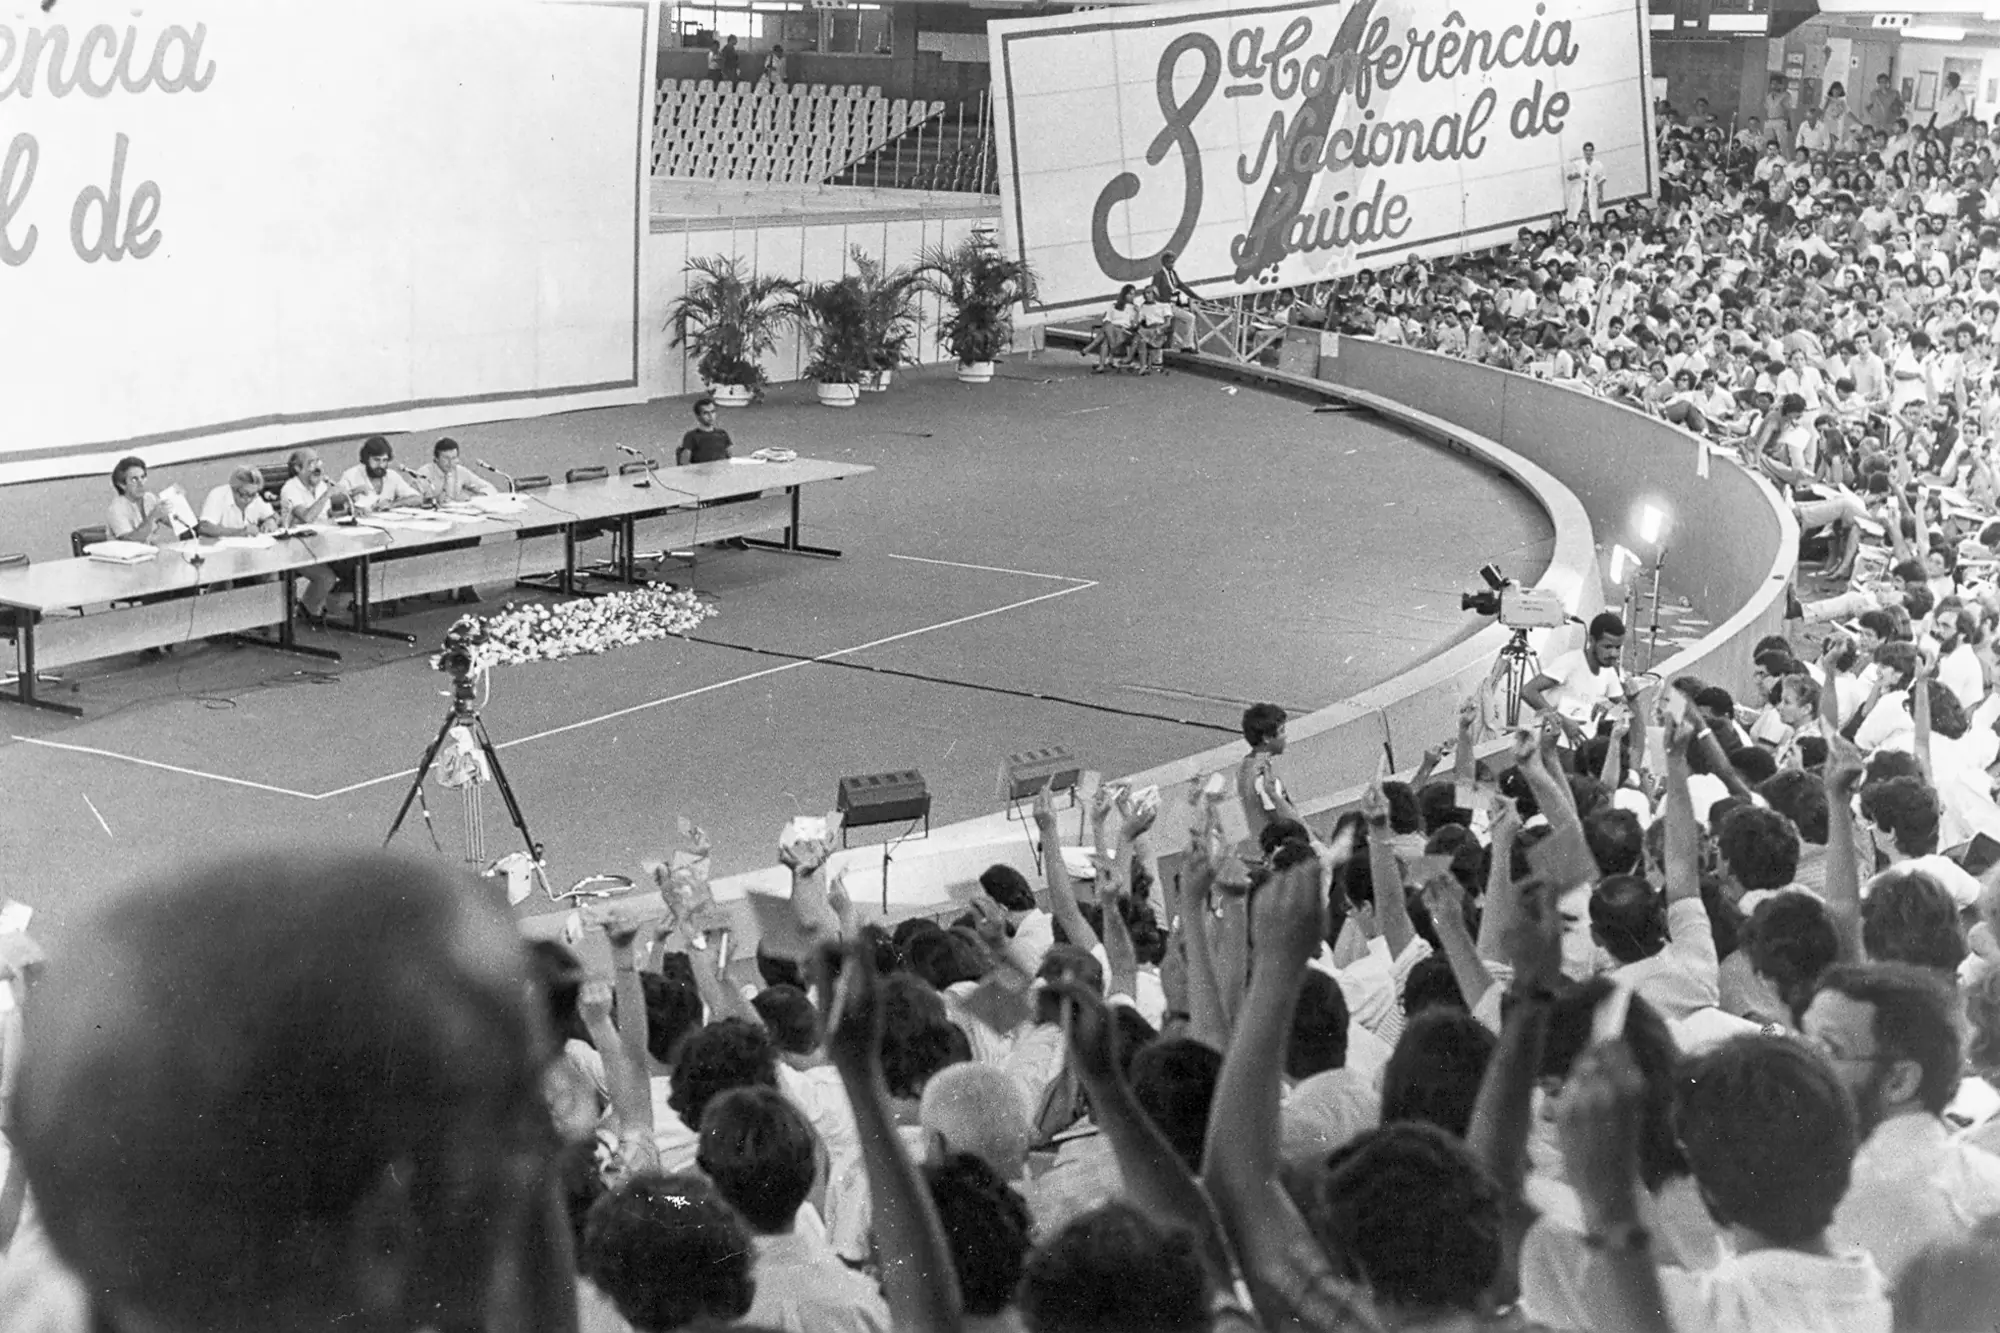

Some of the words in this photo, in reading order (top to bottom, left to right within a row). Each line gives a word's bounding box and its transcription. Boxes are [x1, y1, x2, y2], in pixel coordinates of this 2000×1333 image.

[1261, 2, 1579, 109] Conferência
[1237, 87, 1497, 184] Nacional
[1510, 79, 1570, 139] de
[71, 132, 162, 263] de
[1230, 178, 1413, 267] Saúde
